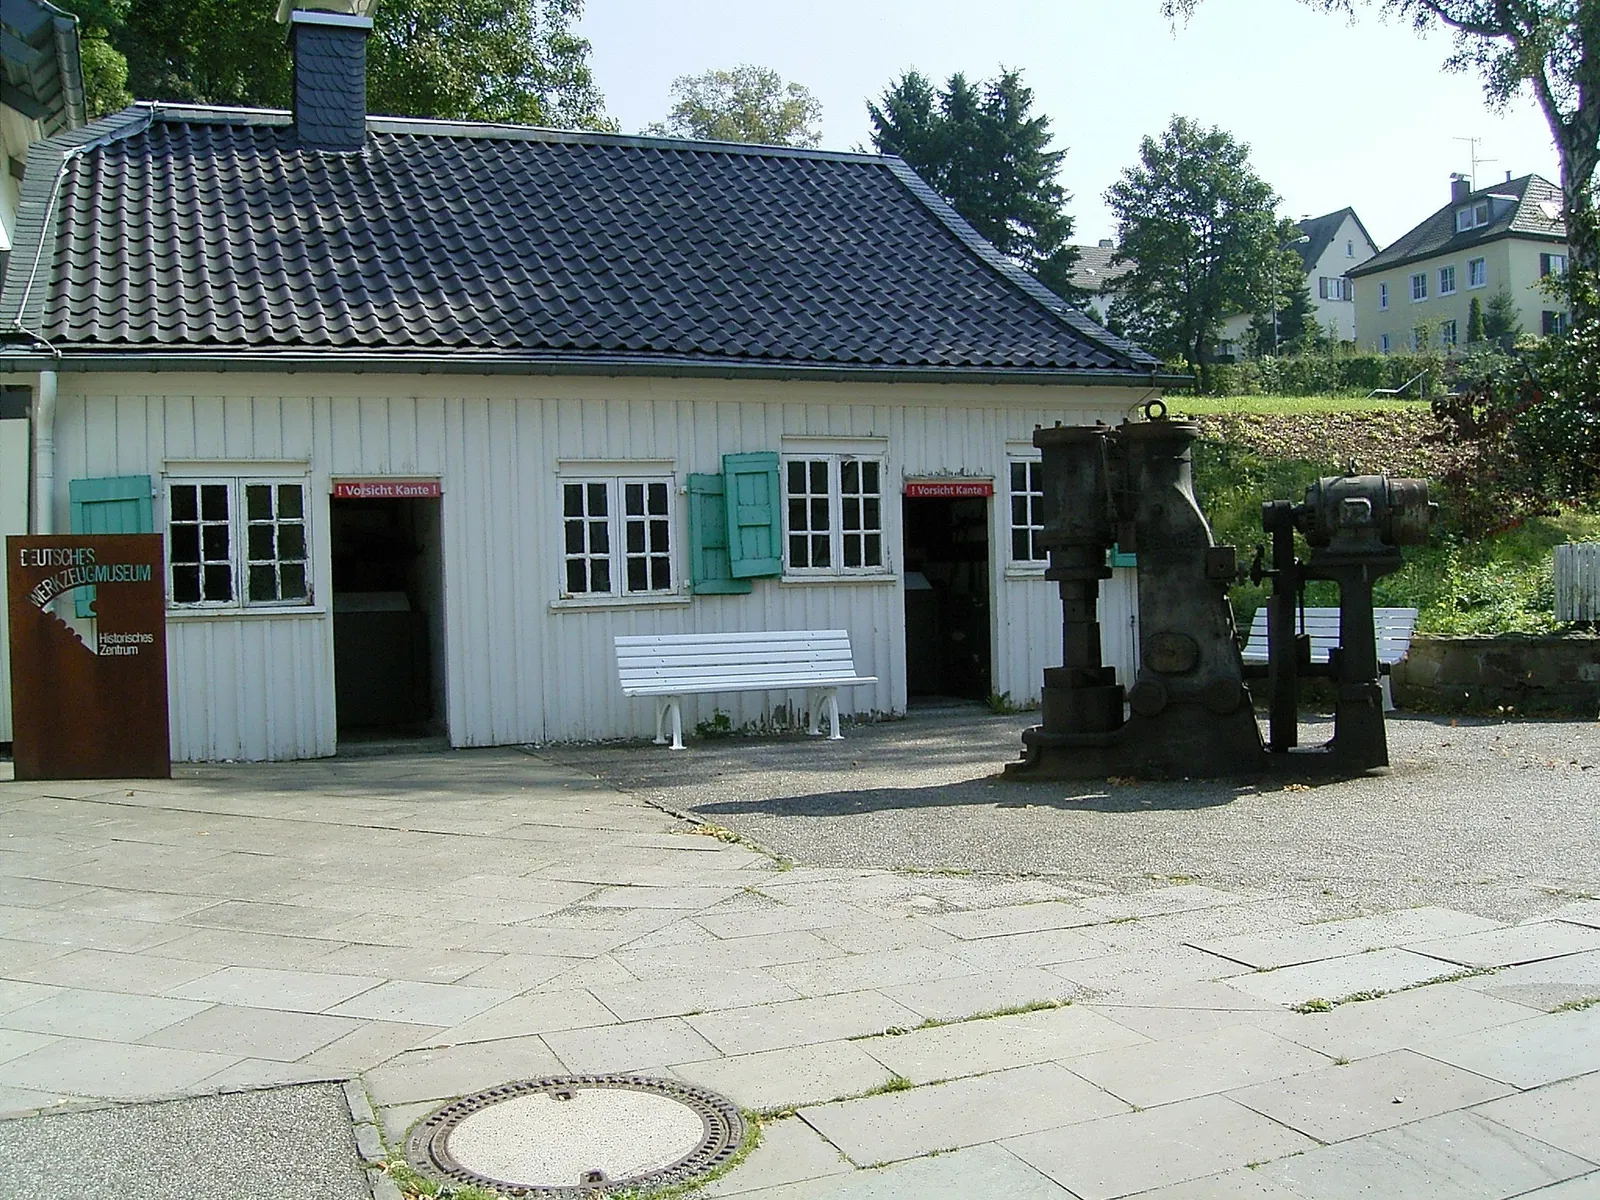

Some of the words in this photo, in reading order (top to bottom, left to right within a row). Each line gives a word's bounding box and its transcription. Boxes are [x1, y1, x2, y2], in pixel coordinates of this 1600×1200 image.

[346, 485, 393, 496] Vorsicht
[395, 485, 430, 496] Kante
[917, 485, 954, 495] Vorsicht
[955, 485, 982, 495] Kante
[20, 547, 96, 567] DEUTSCHES
[28, 564, 152, 608] WERKZEUGMUSEUM
[99, 632, 154, 644] Historisches
[99, 645, 139, 656] Zentrum
